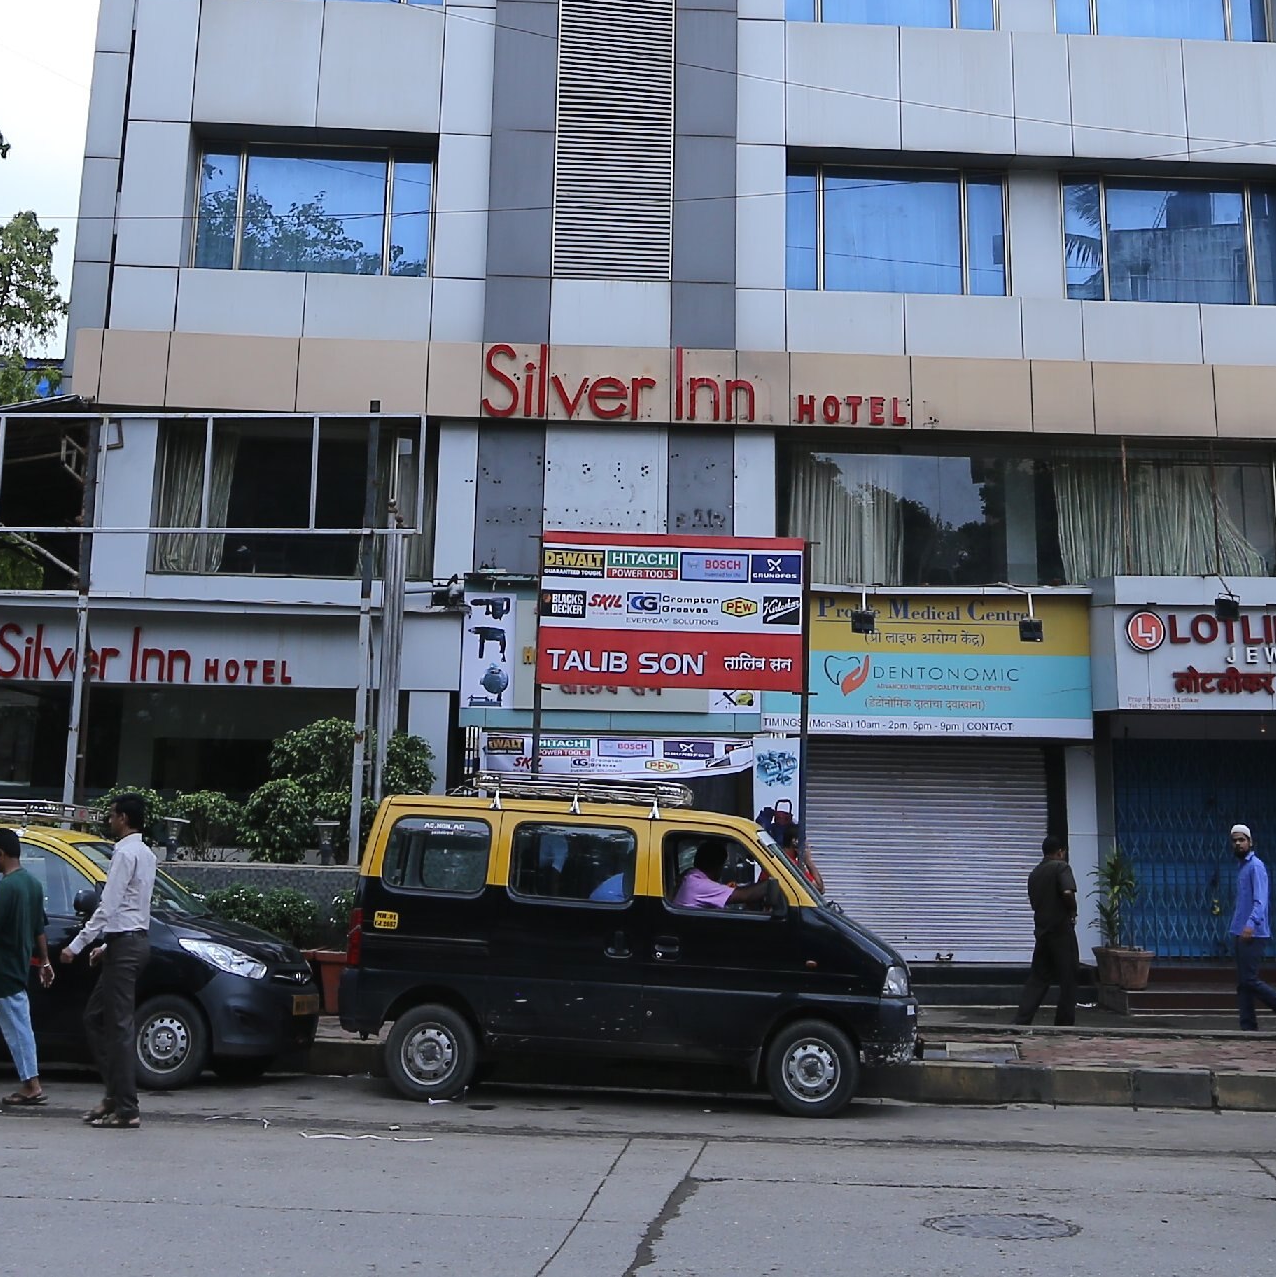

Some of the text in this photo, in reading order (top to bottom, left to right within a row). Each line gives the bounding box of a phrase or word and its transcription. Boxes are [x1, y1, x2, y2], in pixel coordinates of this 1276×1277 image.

[482, 343, 909, 425] Silver Inn HOTEL
[612, 552, 675, 565] HITACHI
[704, 559, 741, 570] BOSCH
[611, 569, 674, 579] POWER TOOLS
[587, 593, 623, 611] SKIL
[662, 595, 719, 605] Crompton
[551, 604, 583, 615] DECKER
[662, 605, 709, 614] Greaves
[726, 600, 753, 614] PEW
[888, 598, 961, 621] Medical
[966, 599, 1030, 622] Centre
[626, 617, 719, 626] EVERYDAY SOLUTIONS
[129, 626, 192, 683] Inn
[204, 658, 293, 685] HOTEL
[547, 649, 629, 674] TALIB
[638, 652, 705, 675] SON
[724, 653, 793, 673] तालिब सन
[872, 665, 1021, 683] DENTONOMIC
[1172, 665, 1276, 696] लोटलीकर
[876, 683, 909, 691] ADVANCED
[856, 720, 880, 729] 10am
[913, 721, 932, 732] 5pm
[940, 722, 960, 732] 9pm
[539, 739, 588, 748] HITACHI
[513, 756, 542, 770] SKL
[649, 762, 674, 770] PEW
